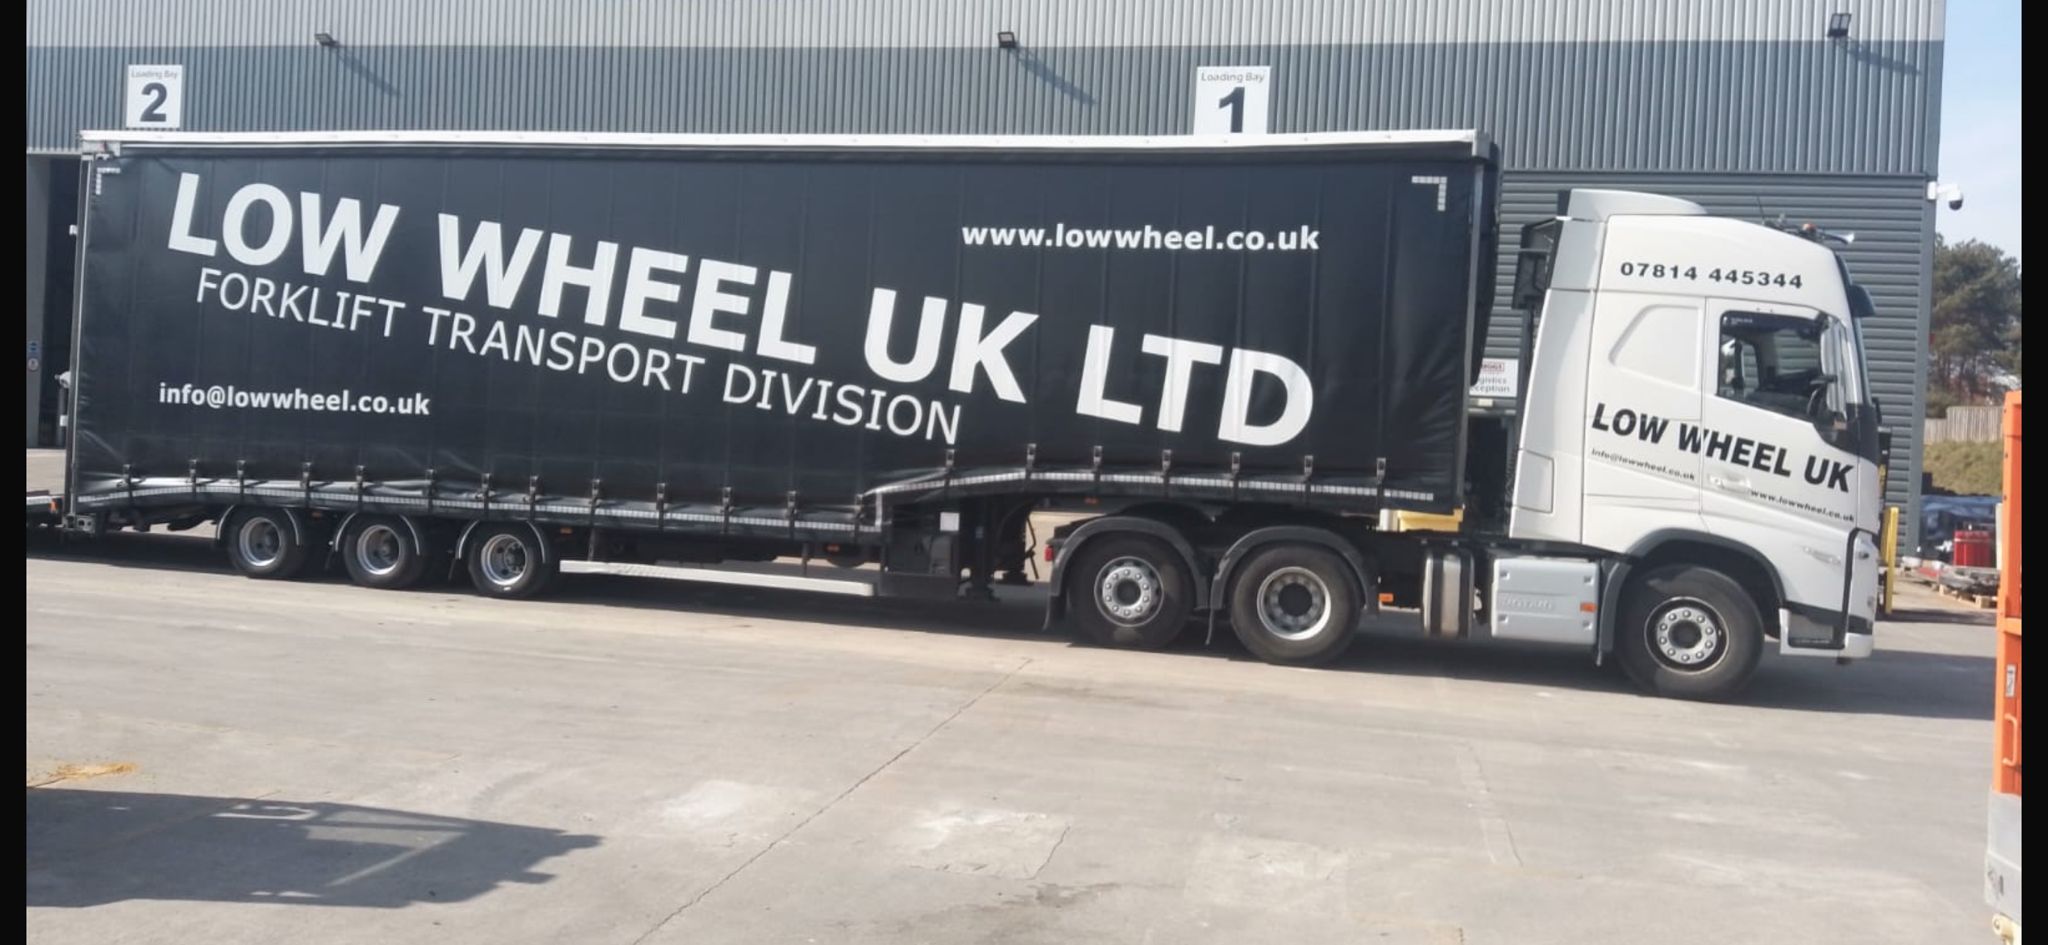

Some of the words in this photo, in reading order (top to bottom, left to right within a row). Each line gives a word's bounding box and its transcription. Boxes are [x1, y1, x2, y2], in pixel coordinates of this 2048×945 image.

[1201, 72, 1243, 83] Loading
[1245, 72, 1265, 83] Bay
[140, 82, 167, 122] 2
[1218, 86, 1245, 133] 1
[961, 222, 1320, 251] www.lowwheel.co.uk
[1620, 261, 1698, 281] 07814
[1708, 267, 1803, 289] 445344
[167, 171, 401, 284] LOW
[437, 212, 817, 365] WHEEL
[863, 287, 1040, 404] UK
[1076, 324, 1314, 446] LTD
[196, 267, 406, 337] FORKLIFT
[422, 306, 706, 394] TRANSPORT
[722, 363, 962, 445] DIVISION
[158, 382, 430, 416] info@lowwheel.co.uk
[1591, 402, 1669, 444] LOW
[1678, 422, 1791, 478] WHEEL
[1803, 455, 1855, 493] UK
[1591, 448, 1695, 480] info@lowwheel.co.uk
[1750, 489, 1855, 522] www.lowwheel.co.uk
